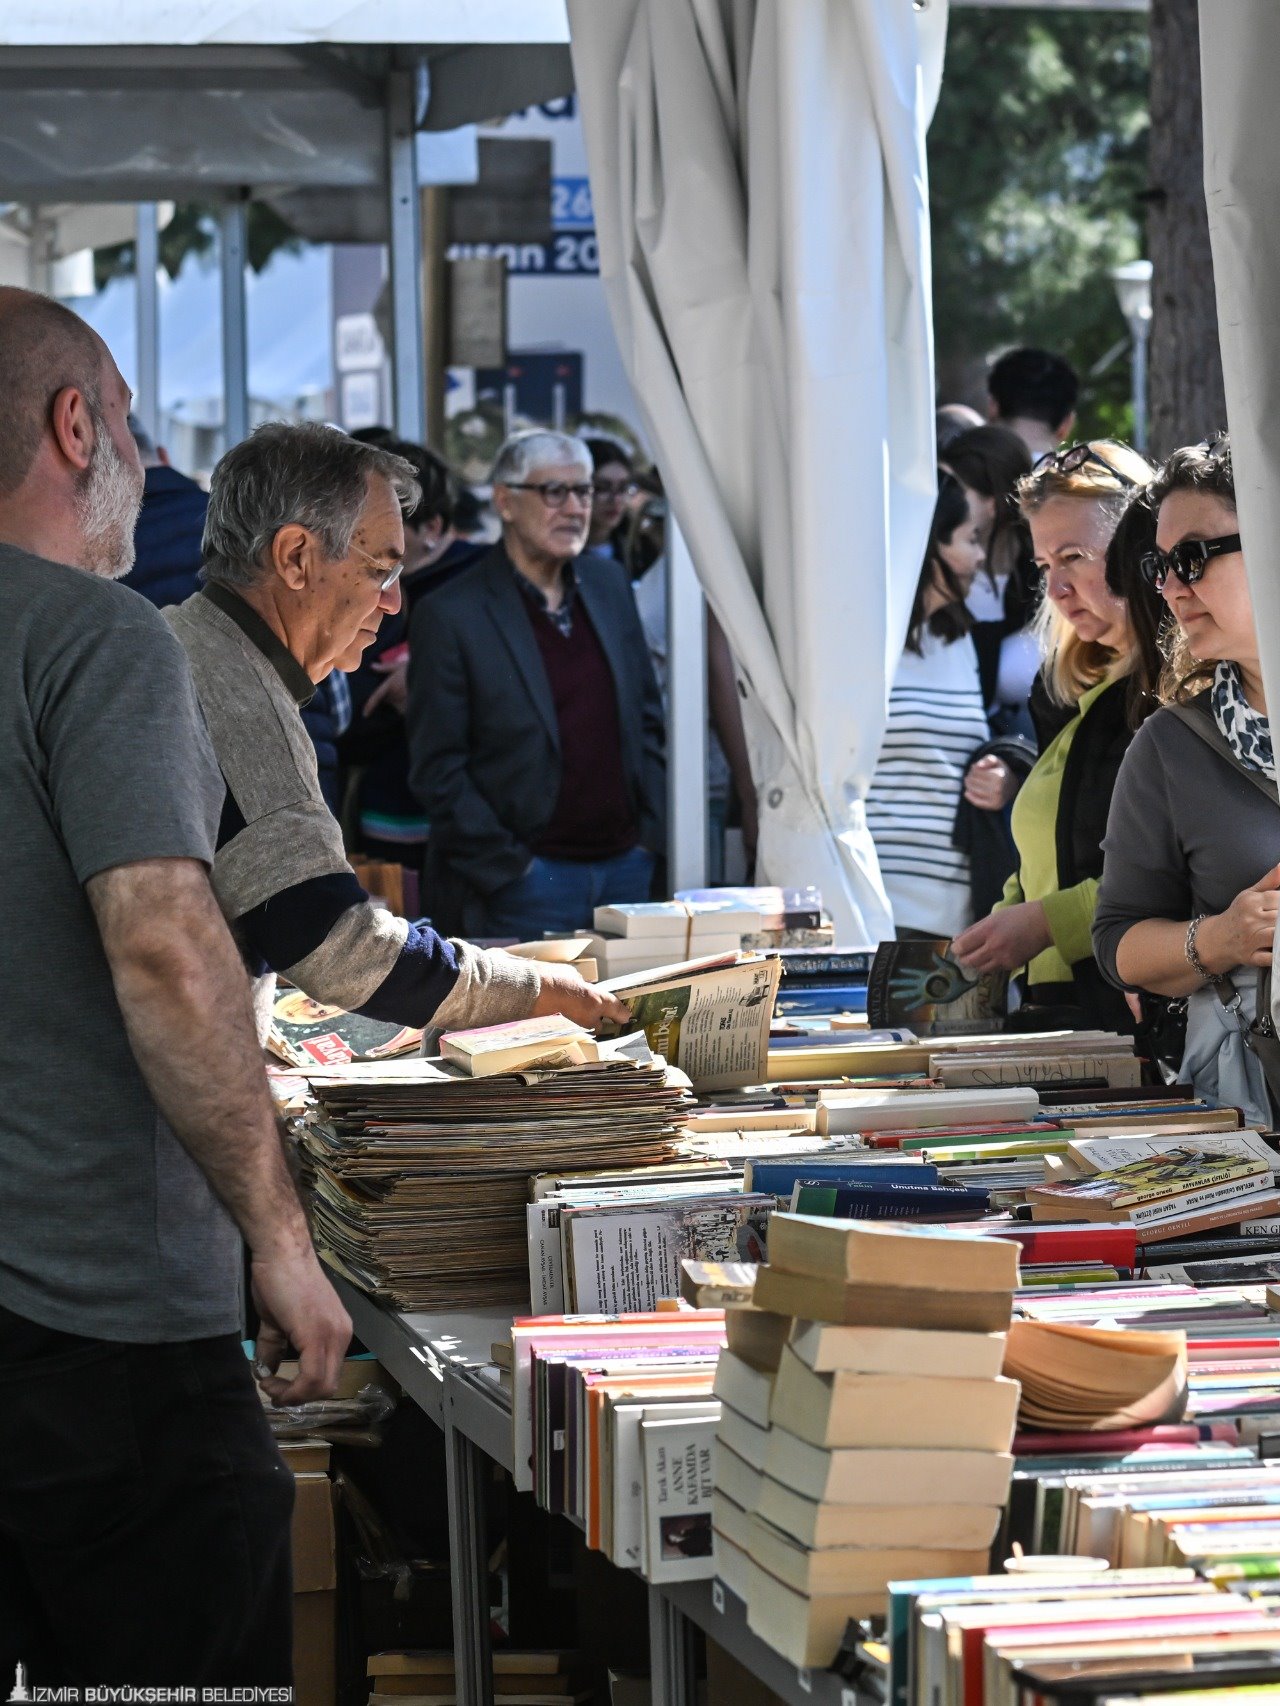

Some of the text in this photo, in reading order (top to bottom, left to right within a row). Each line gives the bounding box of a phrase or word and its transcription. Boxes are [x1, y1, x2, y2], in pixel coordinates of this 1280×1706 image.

[554, 235, 600, 270] 20
[1182, 1178, 1211, 1190] HAYVANLAR
[1136, 1191, 1155, 1202] george
[1141, 1222, 1191, 1237] GEORGE ORWELL
[1245, 1224, 1268, 1236] KEN
[699, 1448, 711, 1474] VAR
[672, 1457, 683, 1492] ANNE
[685, 1443, 698, 1505] KAFAMDA
